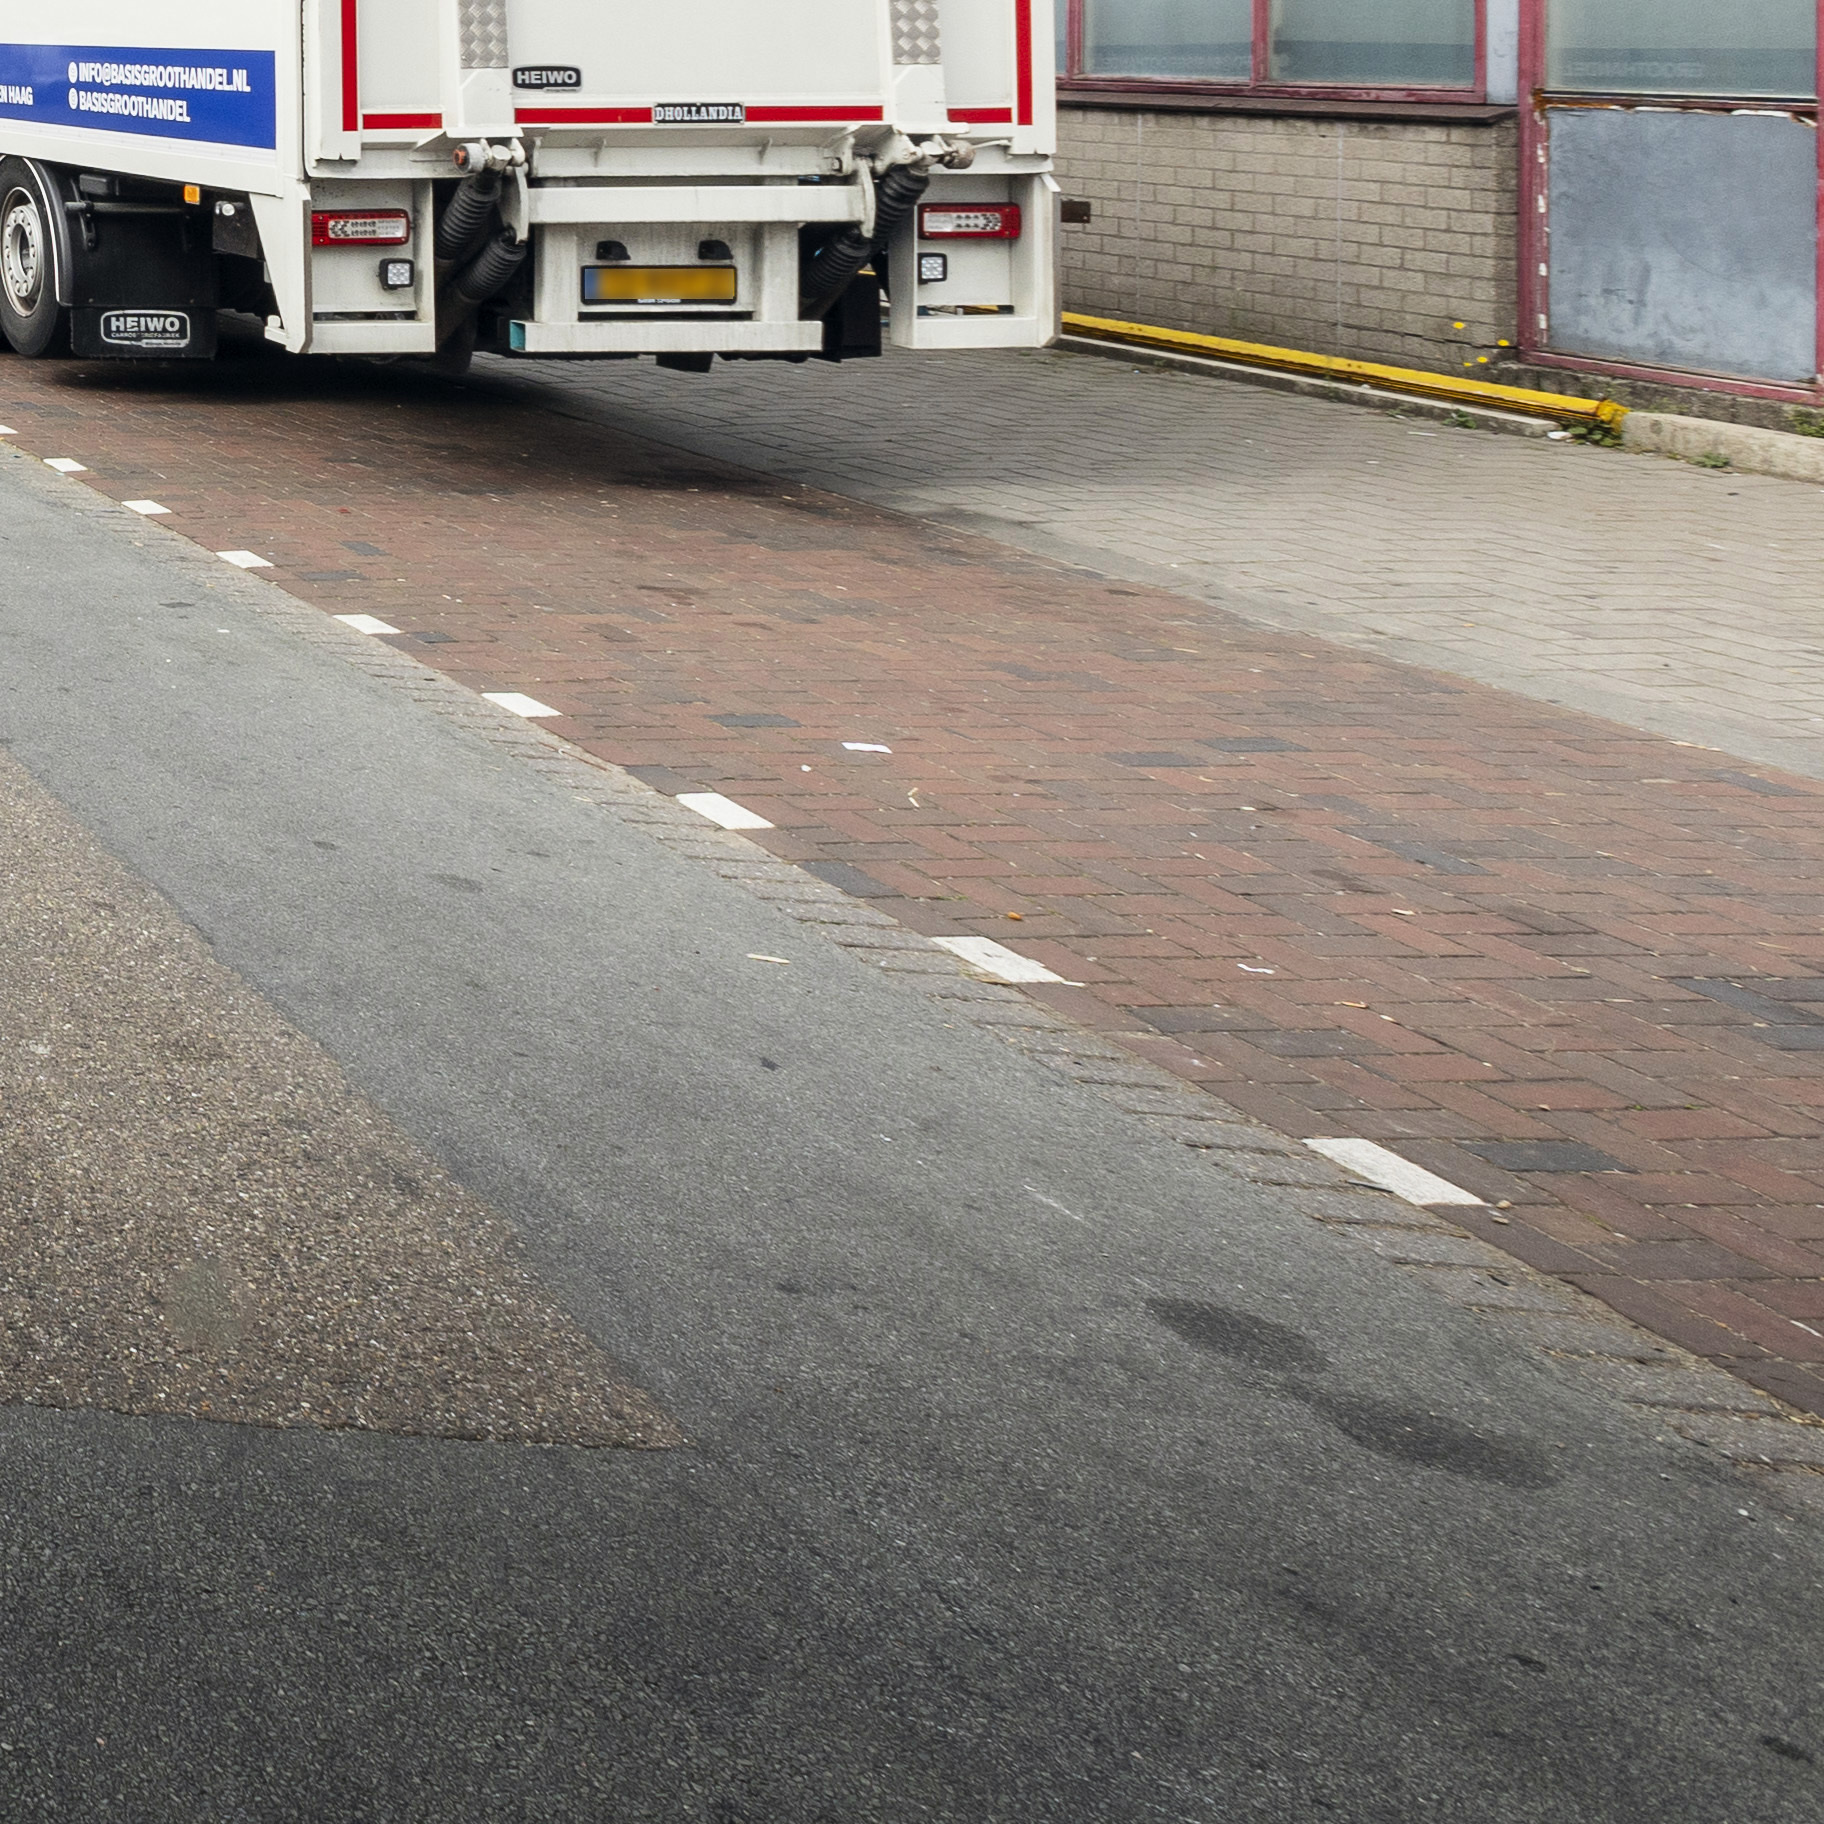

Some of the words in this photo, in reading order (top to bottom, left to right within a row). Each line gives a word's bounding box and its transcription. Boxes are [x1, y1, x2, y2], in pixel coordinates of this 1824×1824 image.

[79, 62, 251, 93] INFO@BASISGROOTHANDEL.NL
[516, 70, 577, 84] HEIWO
[8, 86, 34, 106] HAAG
[79, 90, 191, 123] BASISGROOTHANDEL
[655, 106, 743, 121] DHOLLANDIA
[110, 316, 180, 332] HEIWO
